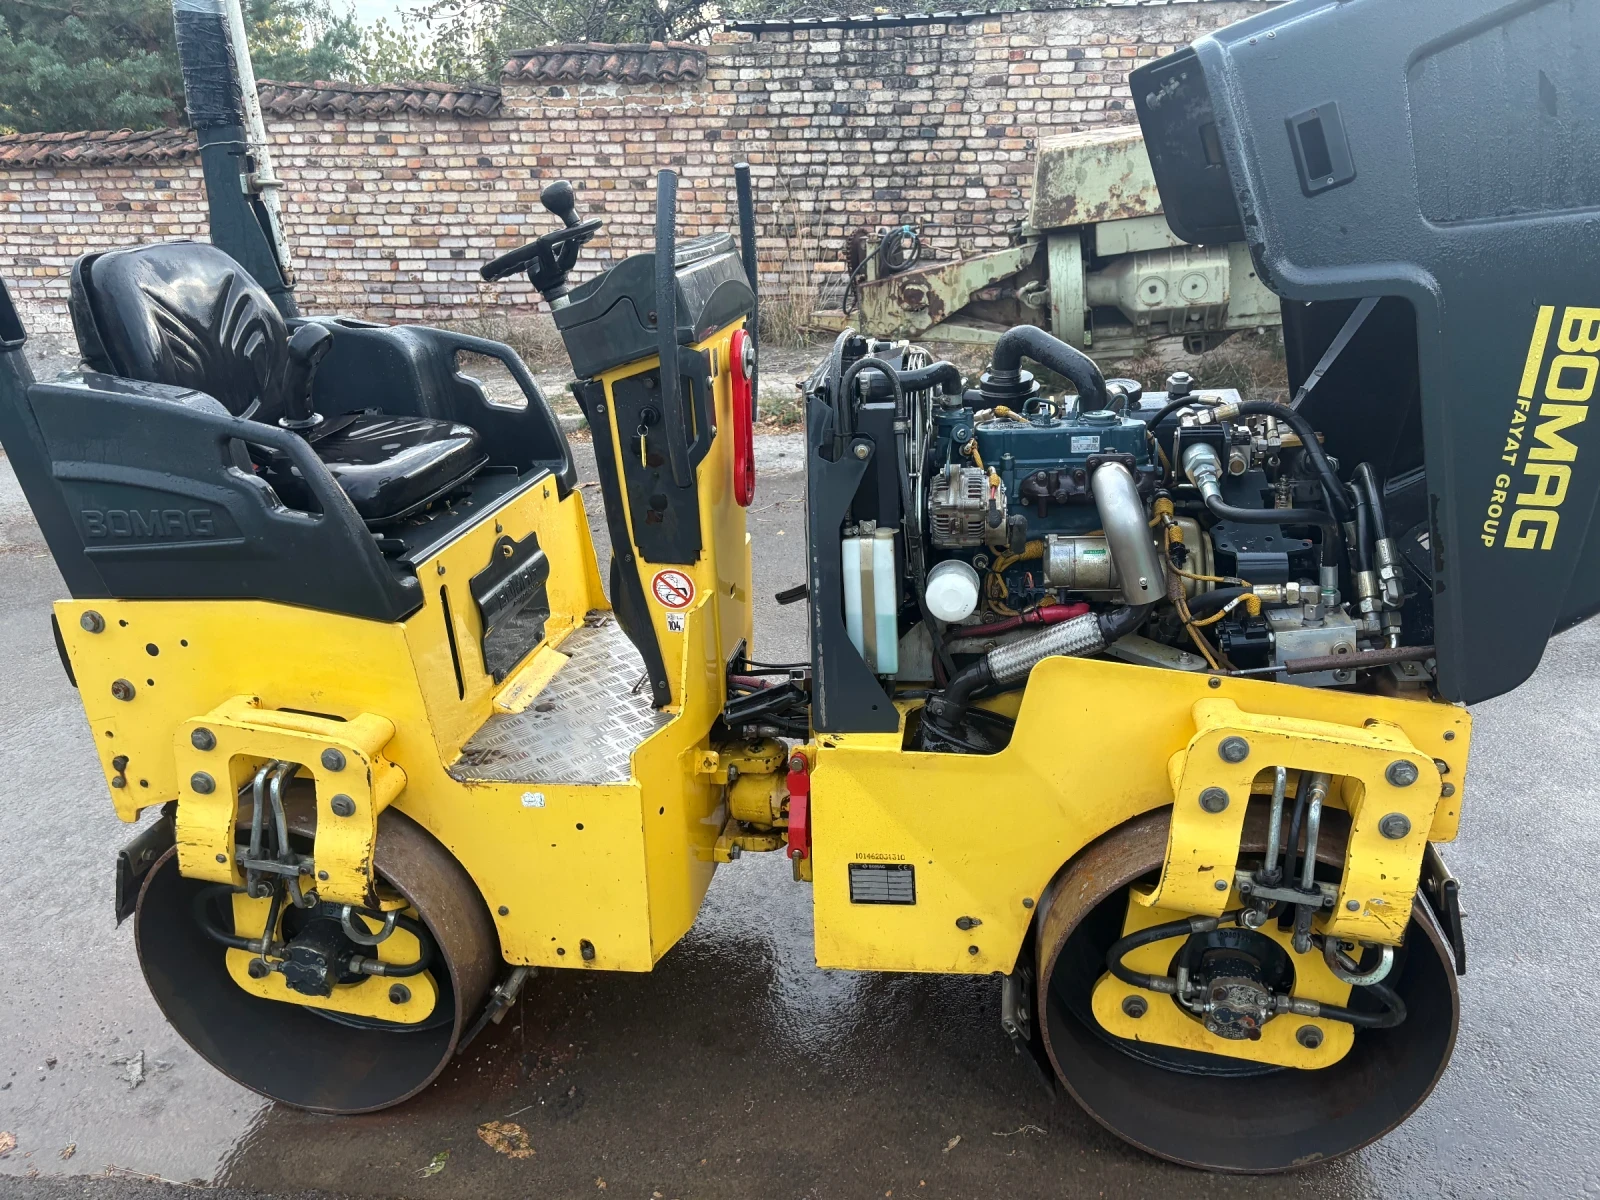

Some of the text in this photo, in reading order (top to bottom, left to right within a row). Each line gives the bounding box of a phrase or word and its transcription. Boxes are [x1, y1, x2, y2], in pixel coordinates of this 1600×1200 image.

[1480, 399, 1531, 548] FAYAT GROUP
[1504, 306, 1600, 551] BOMAG
[81, 509, 216, 538] BOMAG
